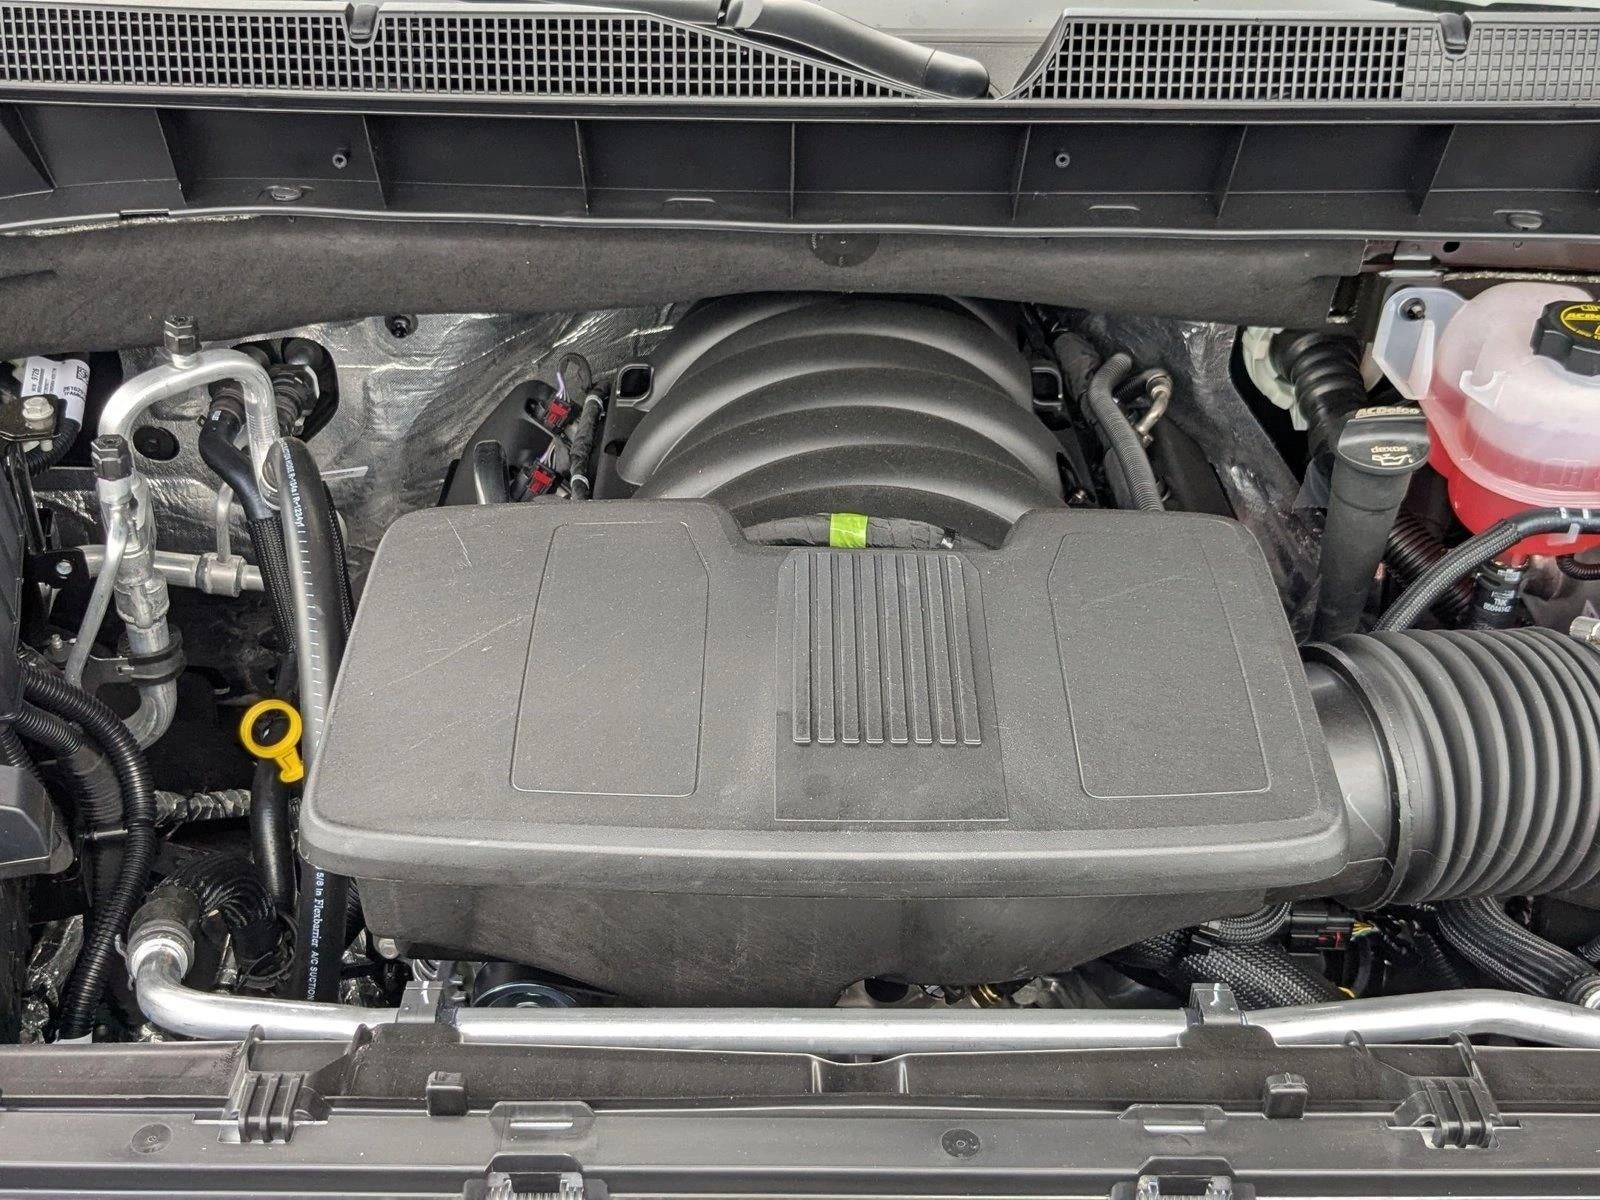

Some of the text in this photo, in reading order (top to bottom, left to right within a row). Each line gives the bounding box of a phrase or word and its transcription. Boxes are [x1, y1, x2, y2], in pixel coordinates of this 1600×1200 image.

[1355, 406, 1420, 418] ACDelco
[316, 872, 325, 886] 5/8
[311, 898, 324, 948] Flexbarrier
[310, 950, 319, 965] A/C
